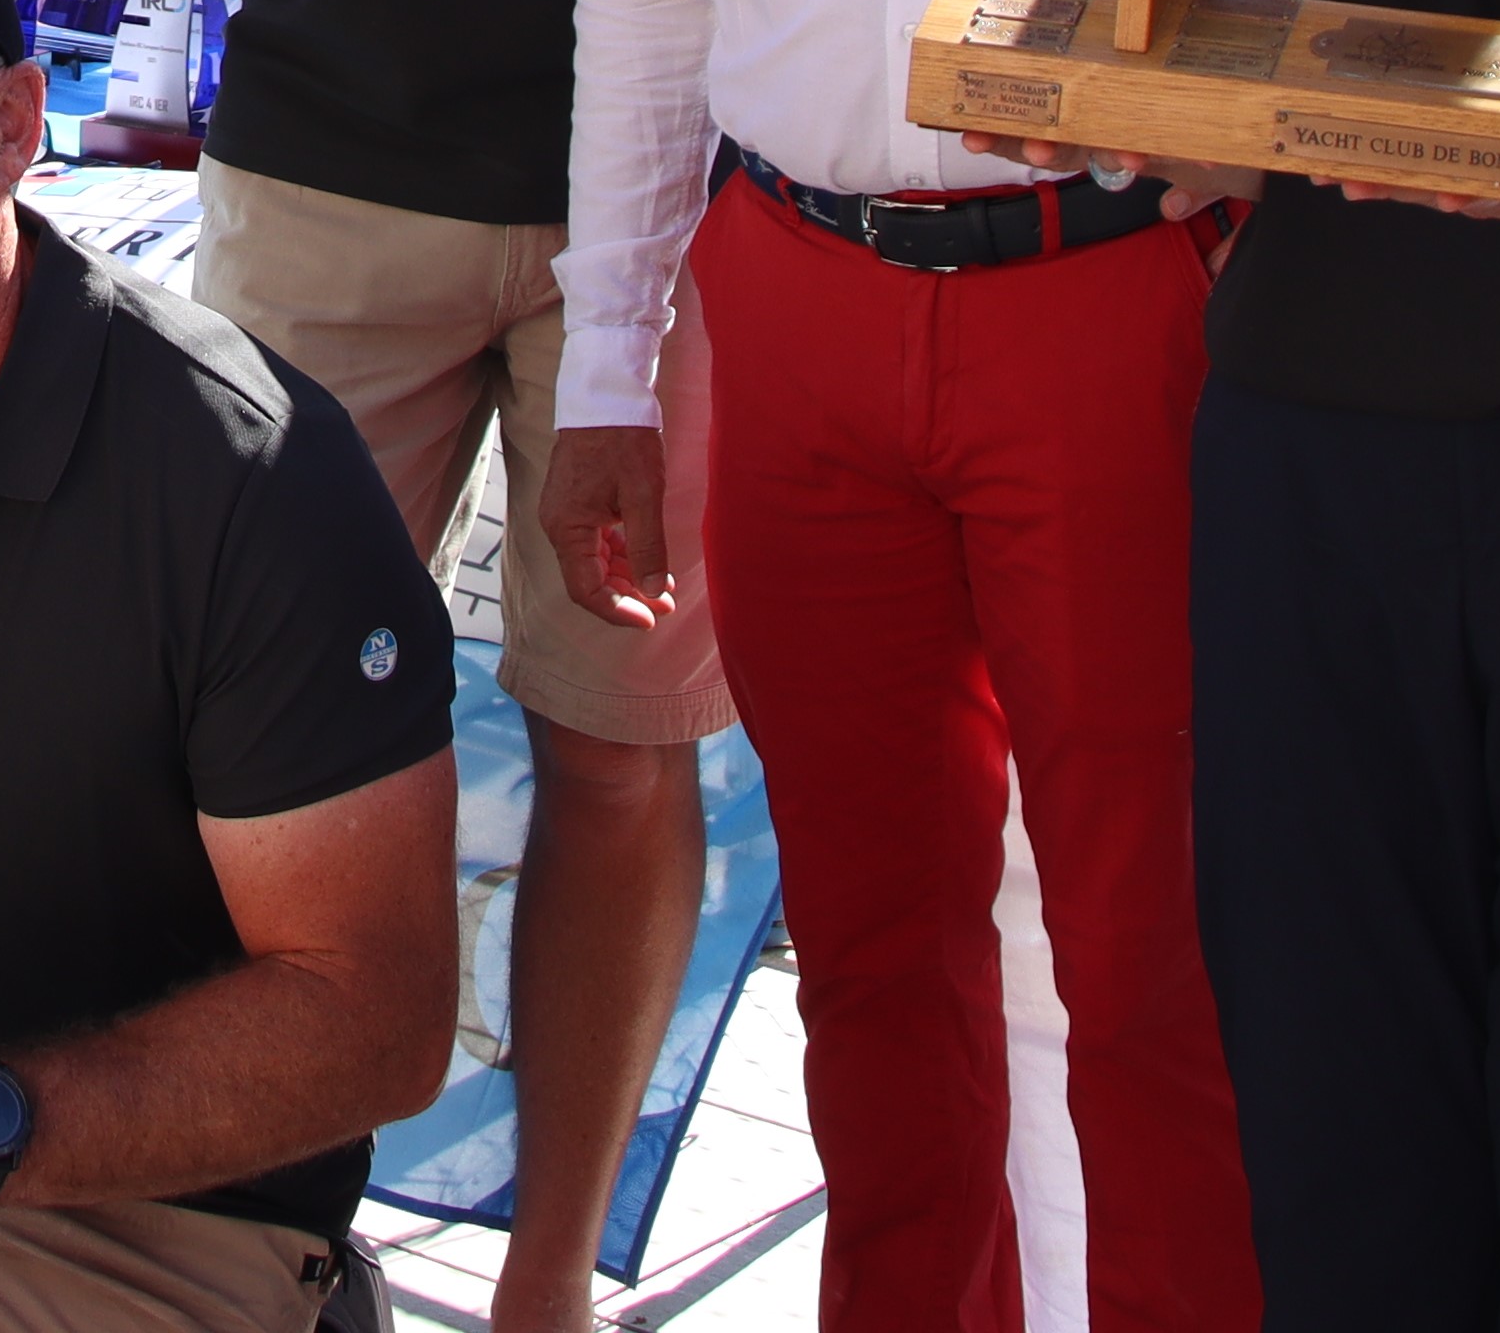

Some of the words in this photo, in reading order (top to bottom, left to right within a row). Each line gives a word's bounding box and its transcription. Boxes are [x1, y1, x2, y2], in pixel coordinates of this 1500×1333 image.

[1293, 127, 1363, 151] YACHT
[1369, 137, 1425, 159] CLUB
[1432, 144, 1461, 164] DE
